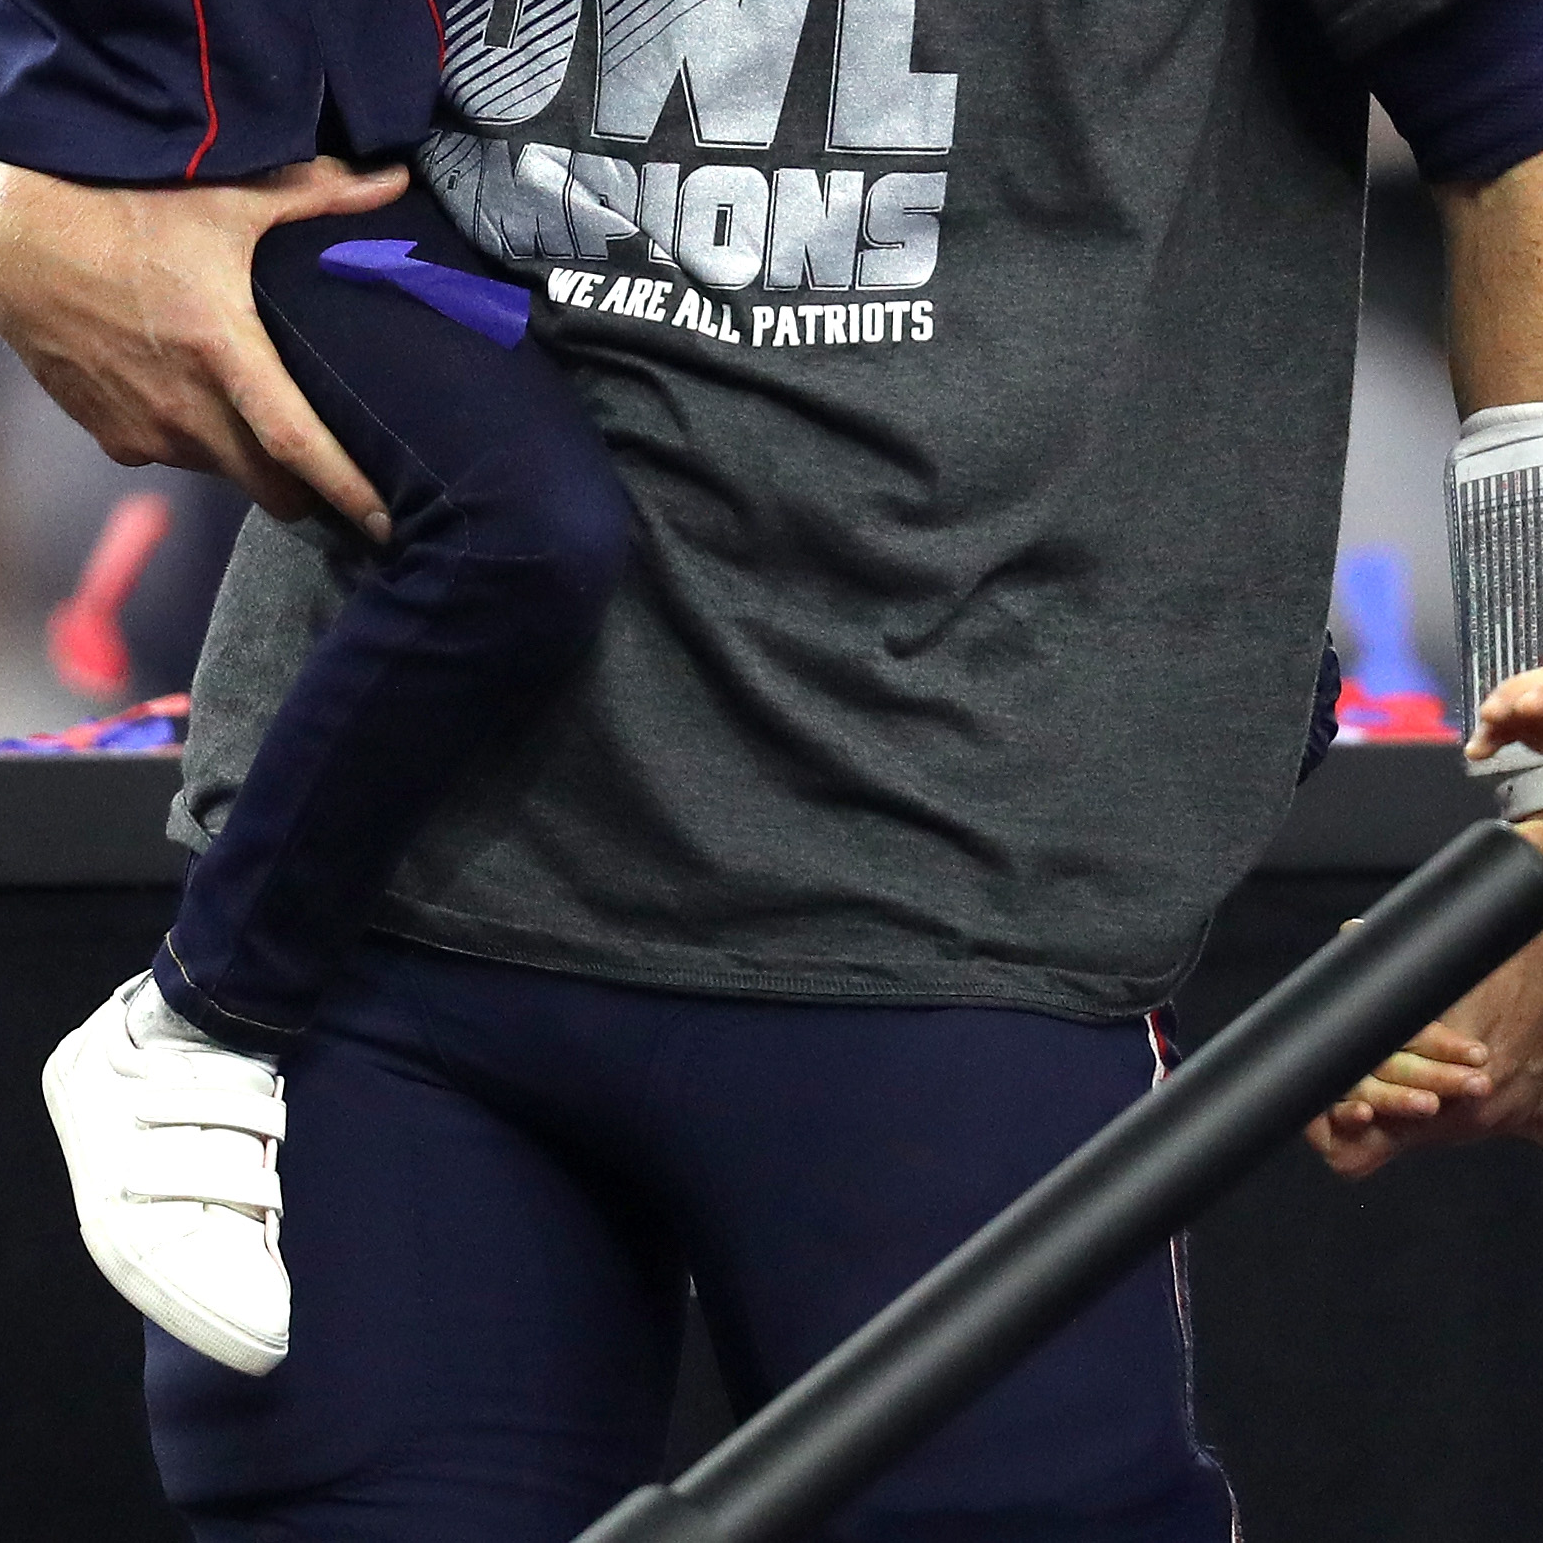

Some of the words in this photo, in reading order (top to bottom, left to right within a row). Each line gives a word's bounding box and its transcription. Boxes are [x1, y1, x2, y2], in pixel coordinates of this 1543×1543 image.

[547, 267, 596, 307] WE
[599, 276, 672, 323] ARE
[675, 286, 741, 345] ALL
[752, 300, 934, 347] PATRIOTS
